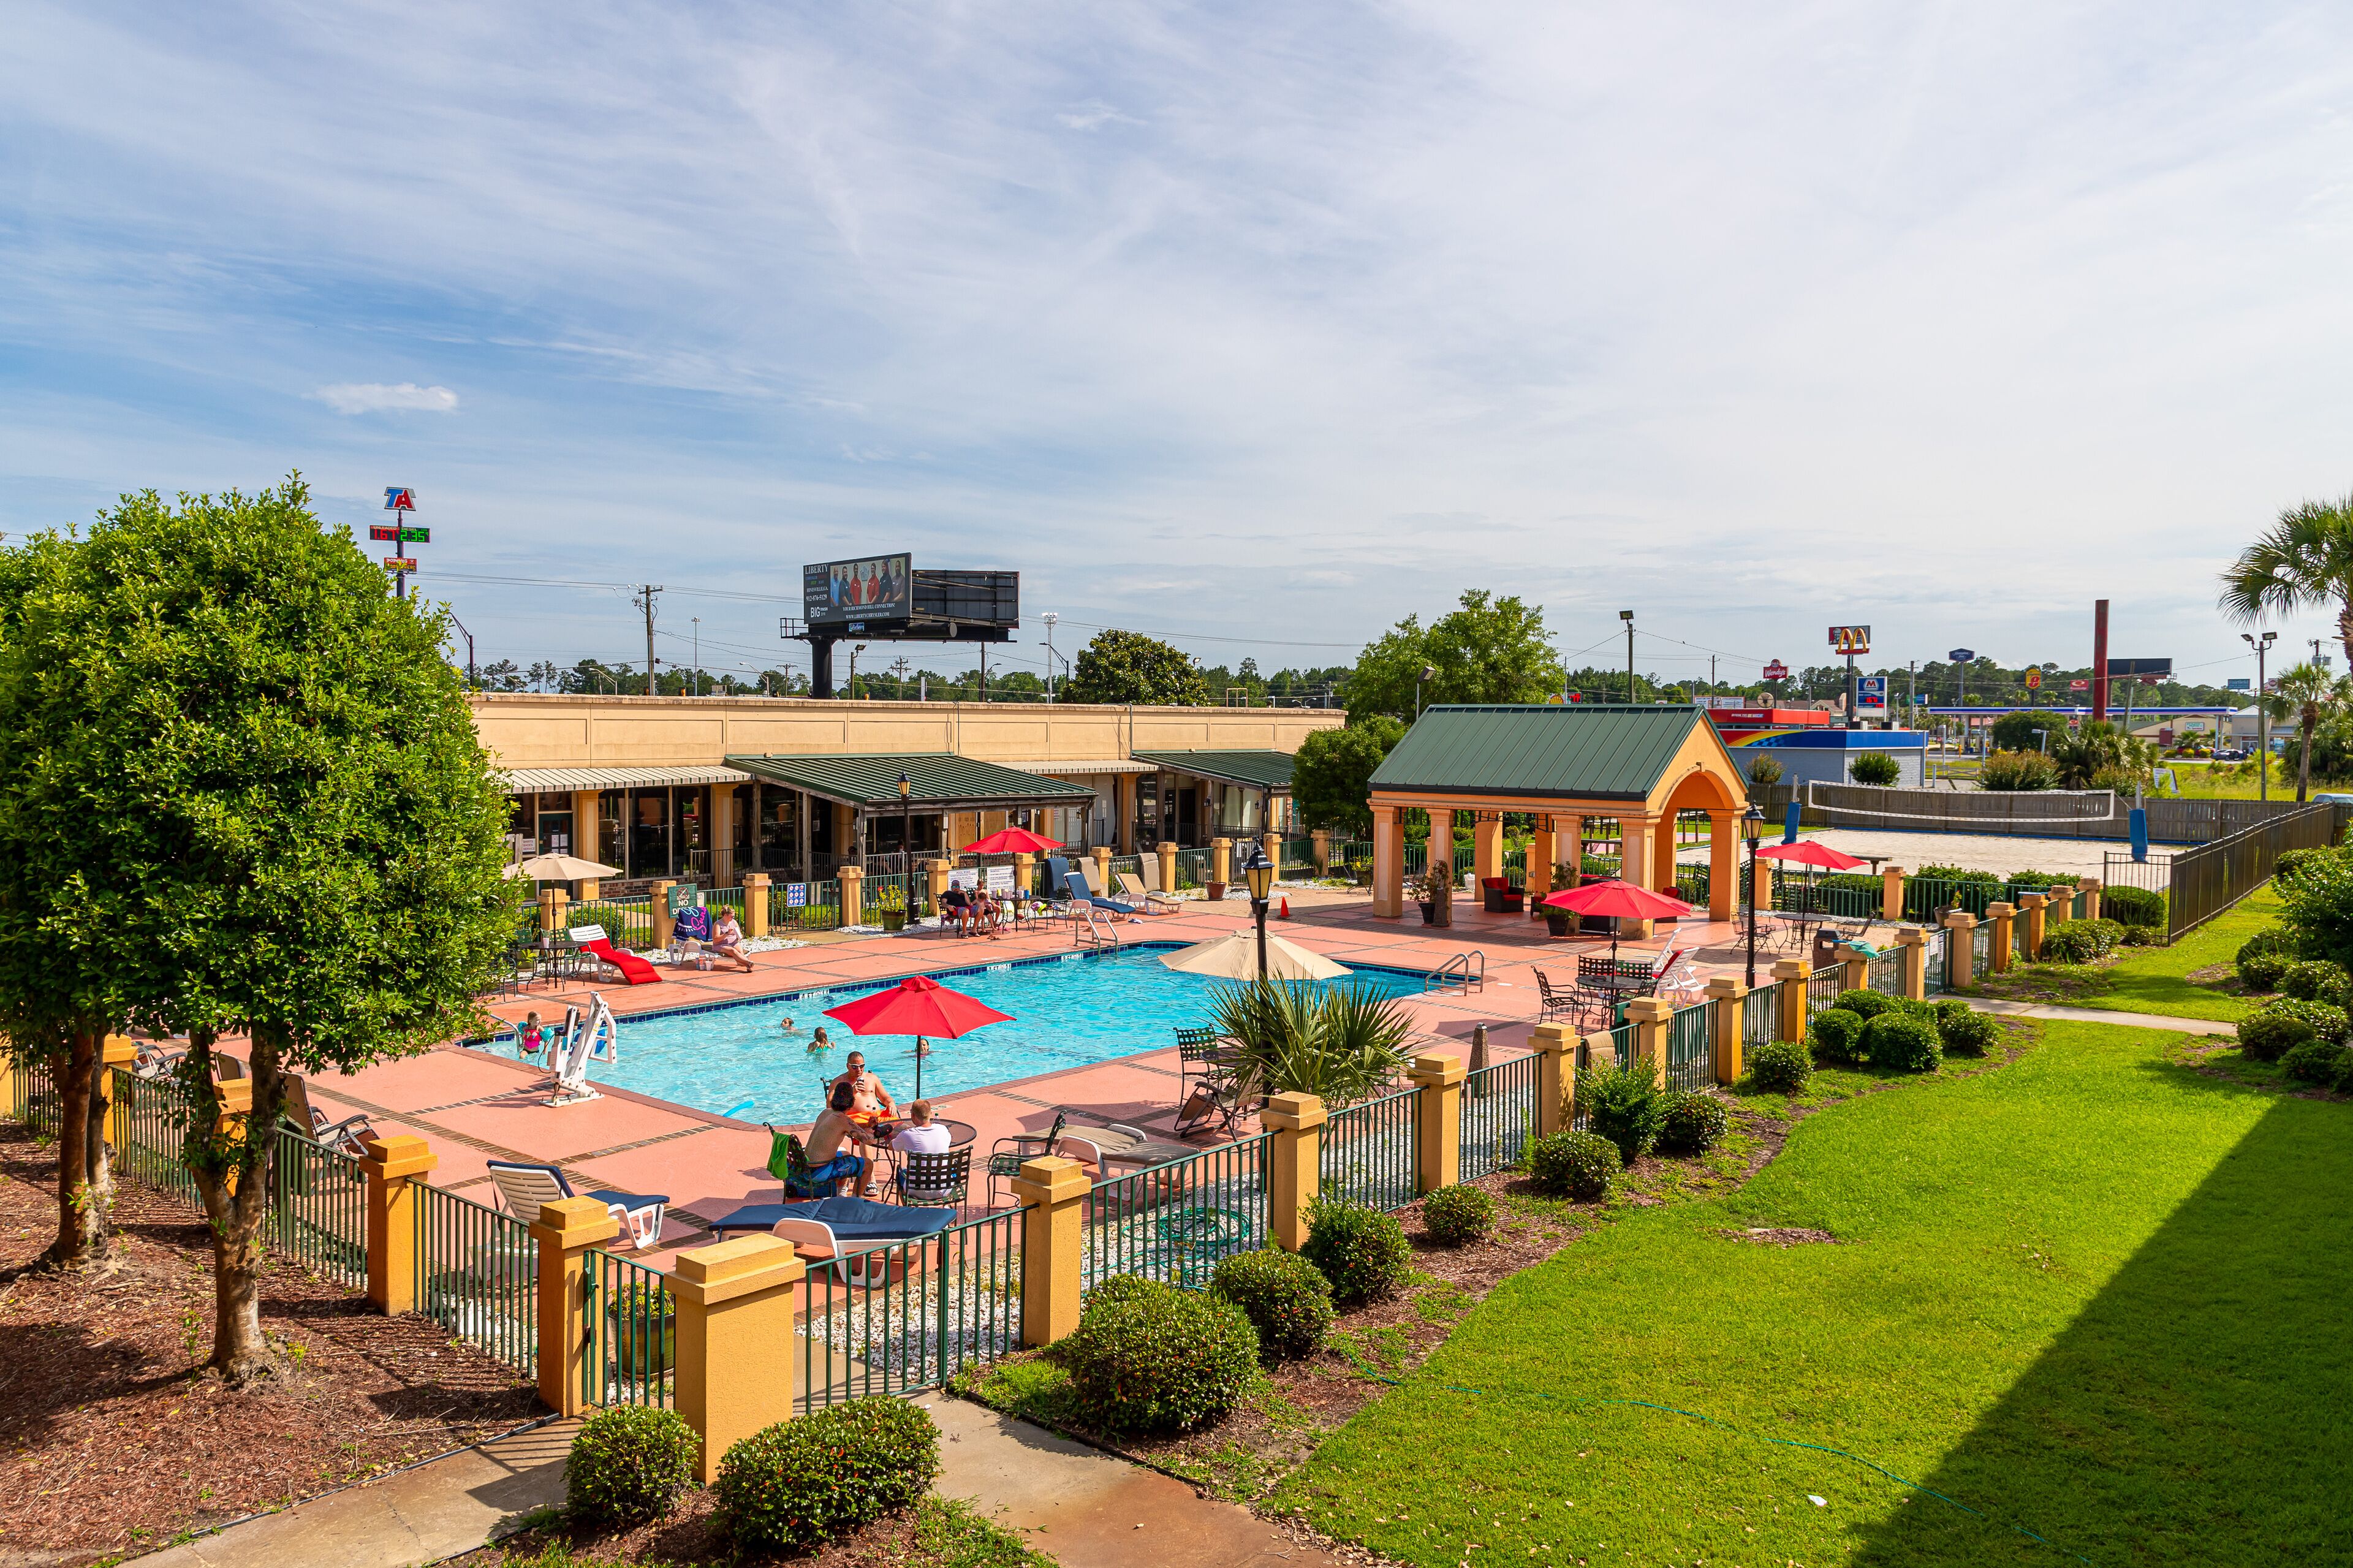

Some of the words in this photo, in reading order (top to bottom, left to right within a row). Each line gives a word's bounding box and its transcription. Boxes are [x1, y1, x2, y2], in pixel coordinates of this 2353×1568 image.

[385, 488, 415, 510] TA
[805, 564, 828, 575] LIBERTY
[810, 606, 820, 618] BIG
[1765, 668, 1786, 678] Wendy's
